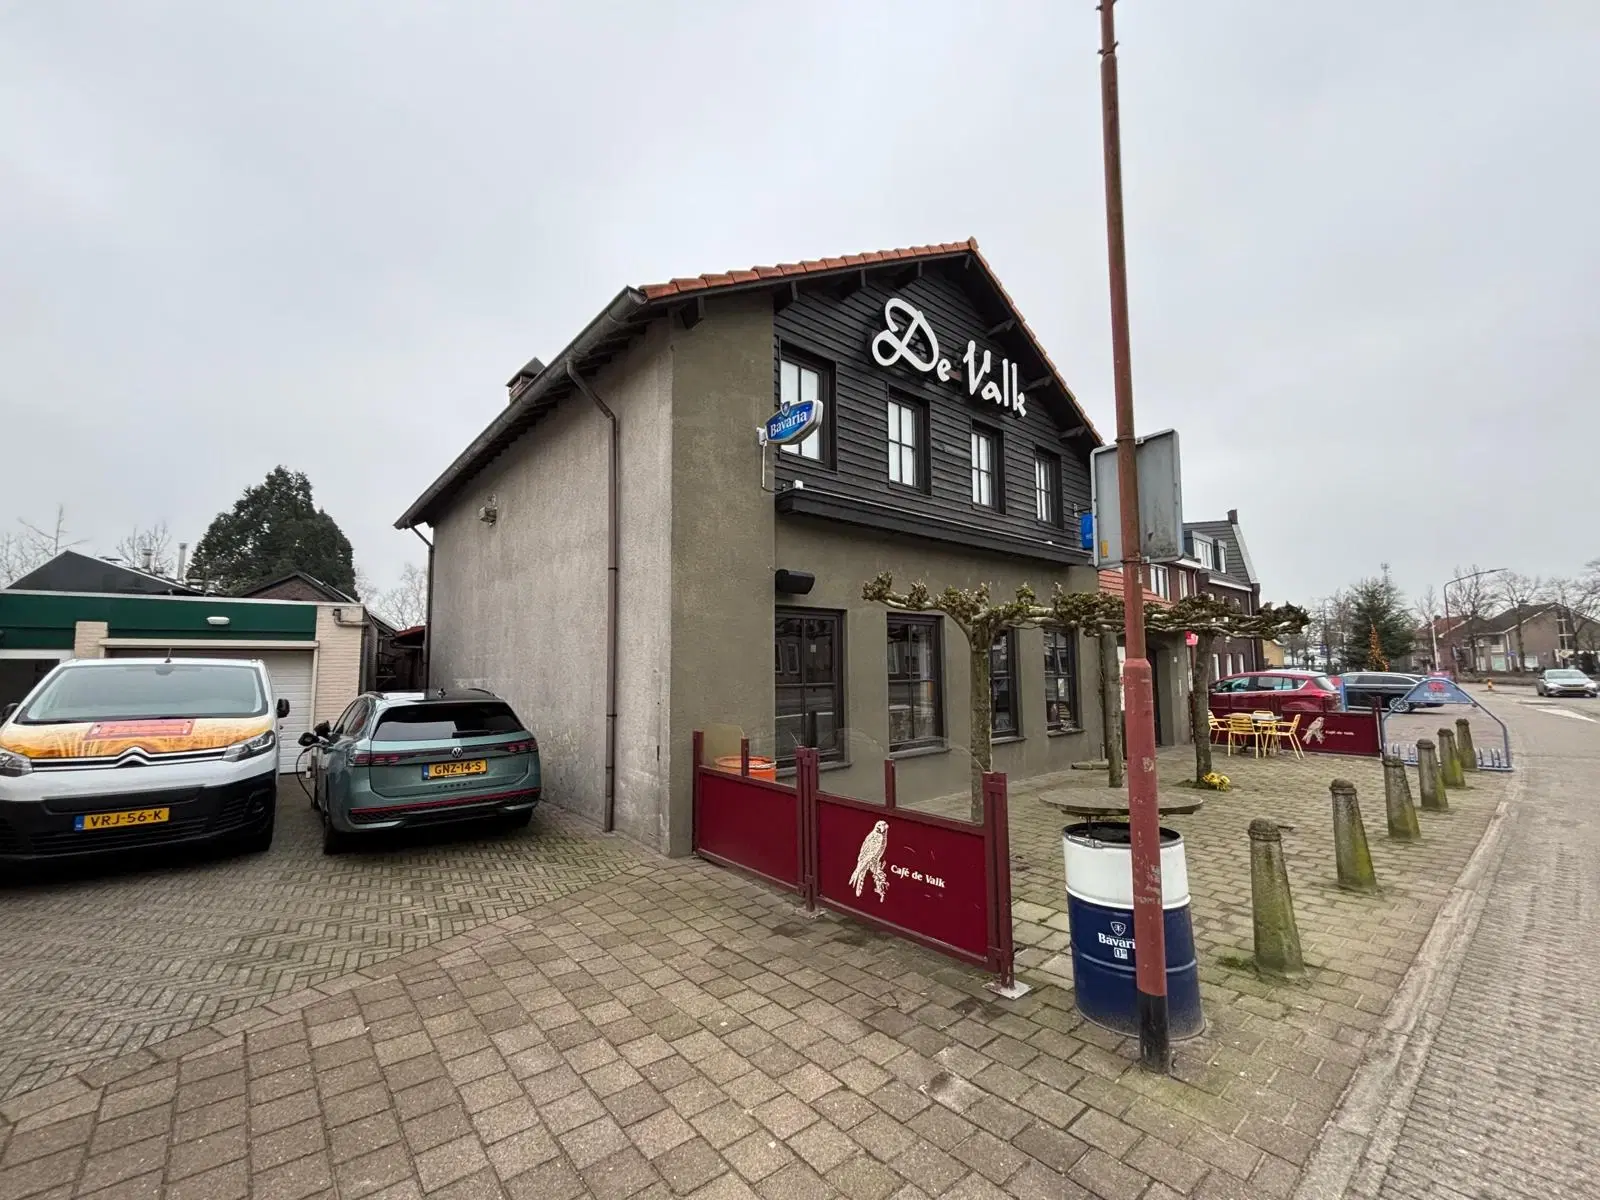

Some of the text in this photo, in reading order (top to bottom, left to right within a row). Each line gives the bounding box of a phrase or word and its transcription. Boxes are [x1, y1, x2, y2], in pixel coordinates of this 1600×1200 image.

[872, 298, 1027, 417] De Valk
[770, 410, 808, 438] Bavaria
[434, 761, 482, 775] GNZ-14-S
[90, 809, 162, 827] VRJ-56-K
[890, 864, 946, 888] Café de Valk
[1098, 932, 1136, 949] Bavari
